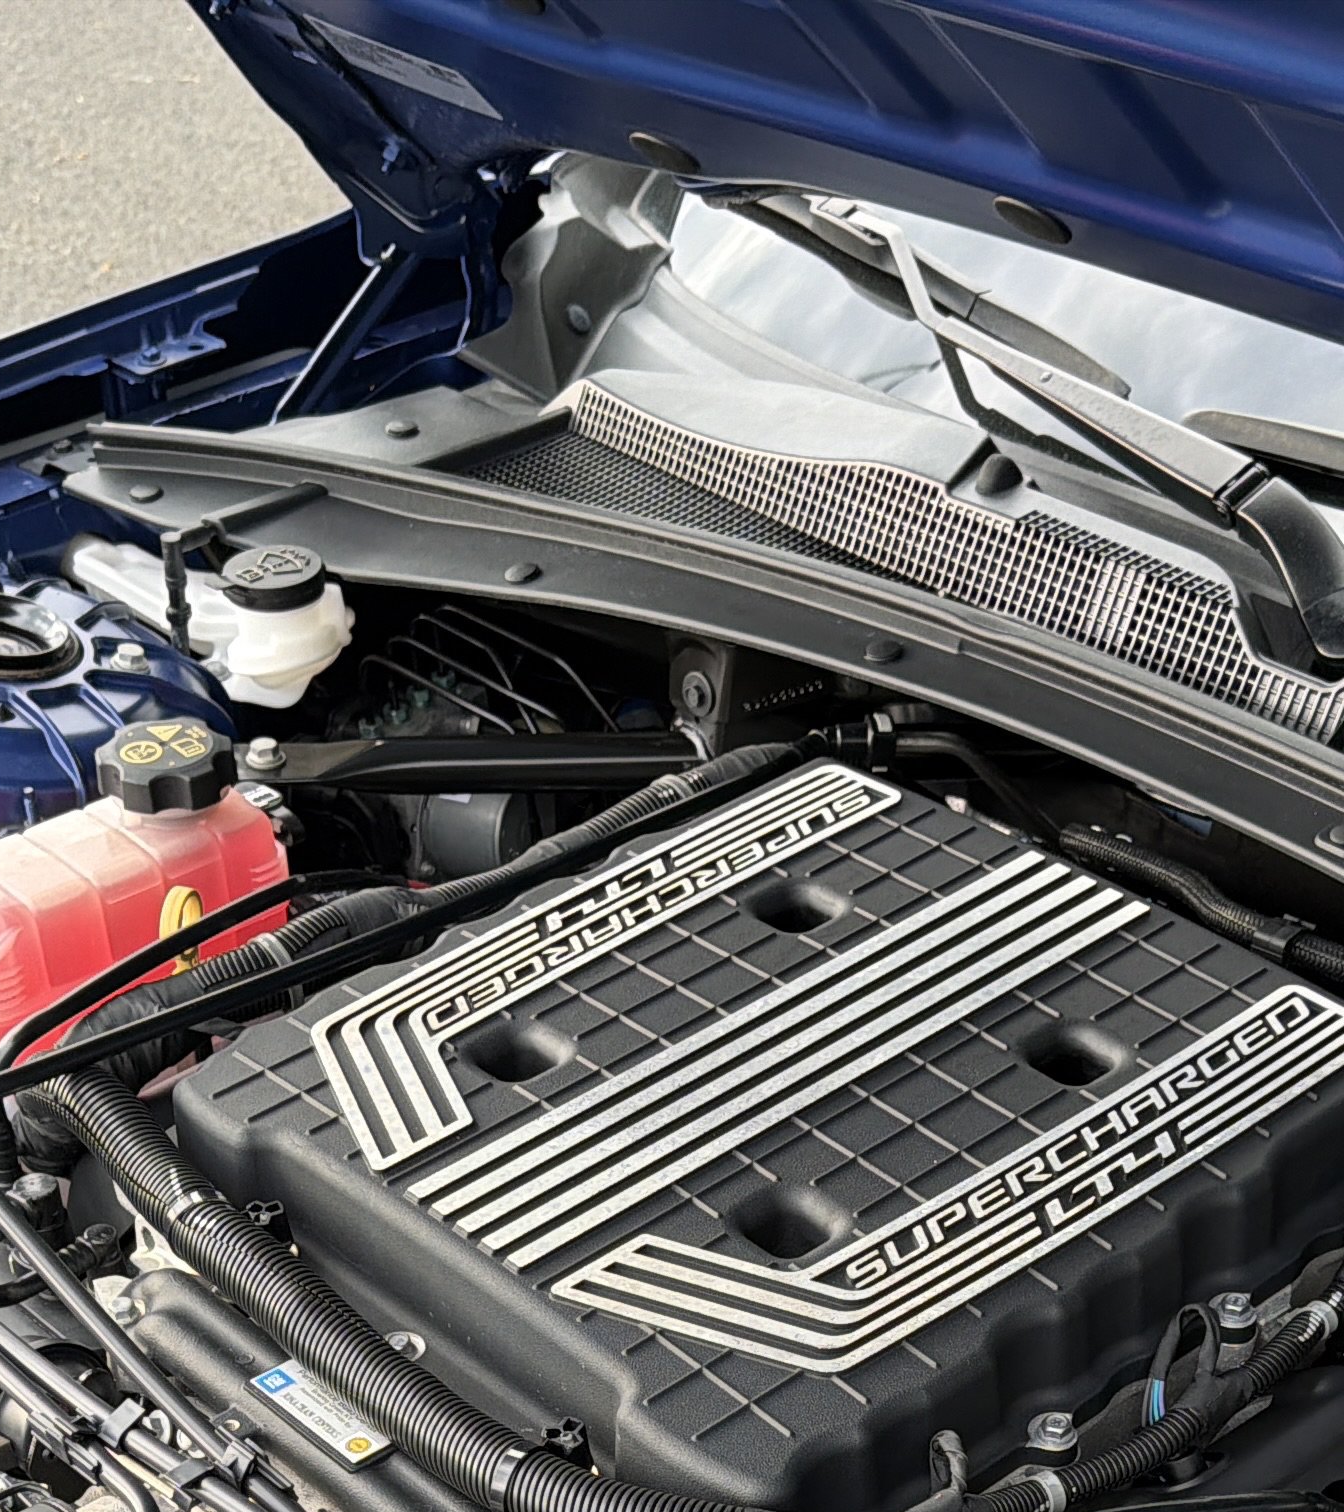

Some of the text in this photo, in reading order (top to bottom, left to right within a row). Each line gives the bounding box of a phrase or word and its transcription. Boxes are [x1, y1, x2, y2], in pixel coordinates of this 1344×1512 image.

[425, 787, 873, 1032] SUPERCHARGED
[545, 849, 675, 933] LT4
[845, 995, 1312, 1285] SUPERCHARGED
[1041, 1128, 1178, 1230] LT4
